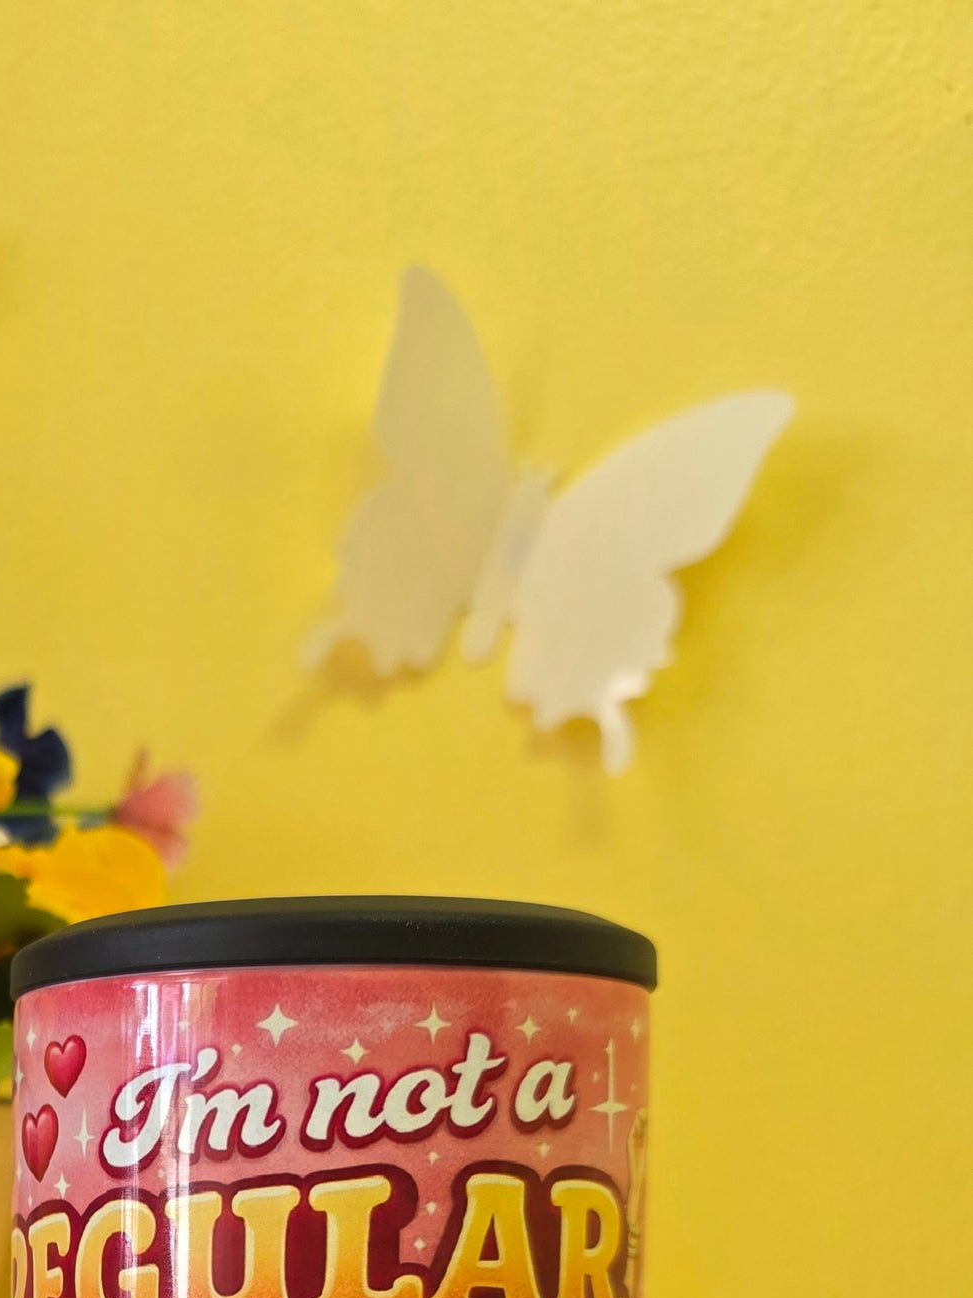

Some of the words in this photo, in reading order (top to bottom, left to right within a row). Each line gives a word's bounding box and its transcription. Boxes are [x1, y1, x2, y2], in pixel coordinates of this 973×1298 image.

[103, 1047, 285, 1168] I'm
[305, 1032, 505, 1139] not
[515, 1056, 576, 1121] a
